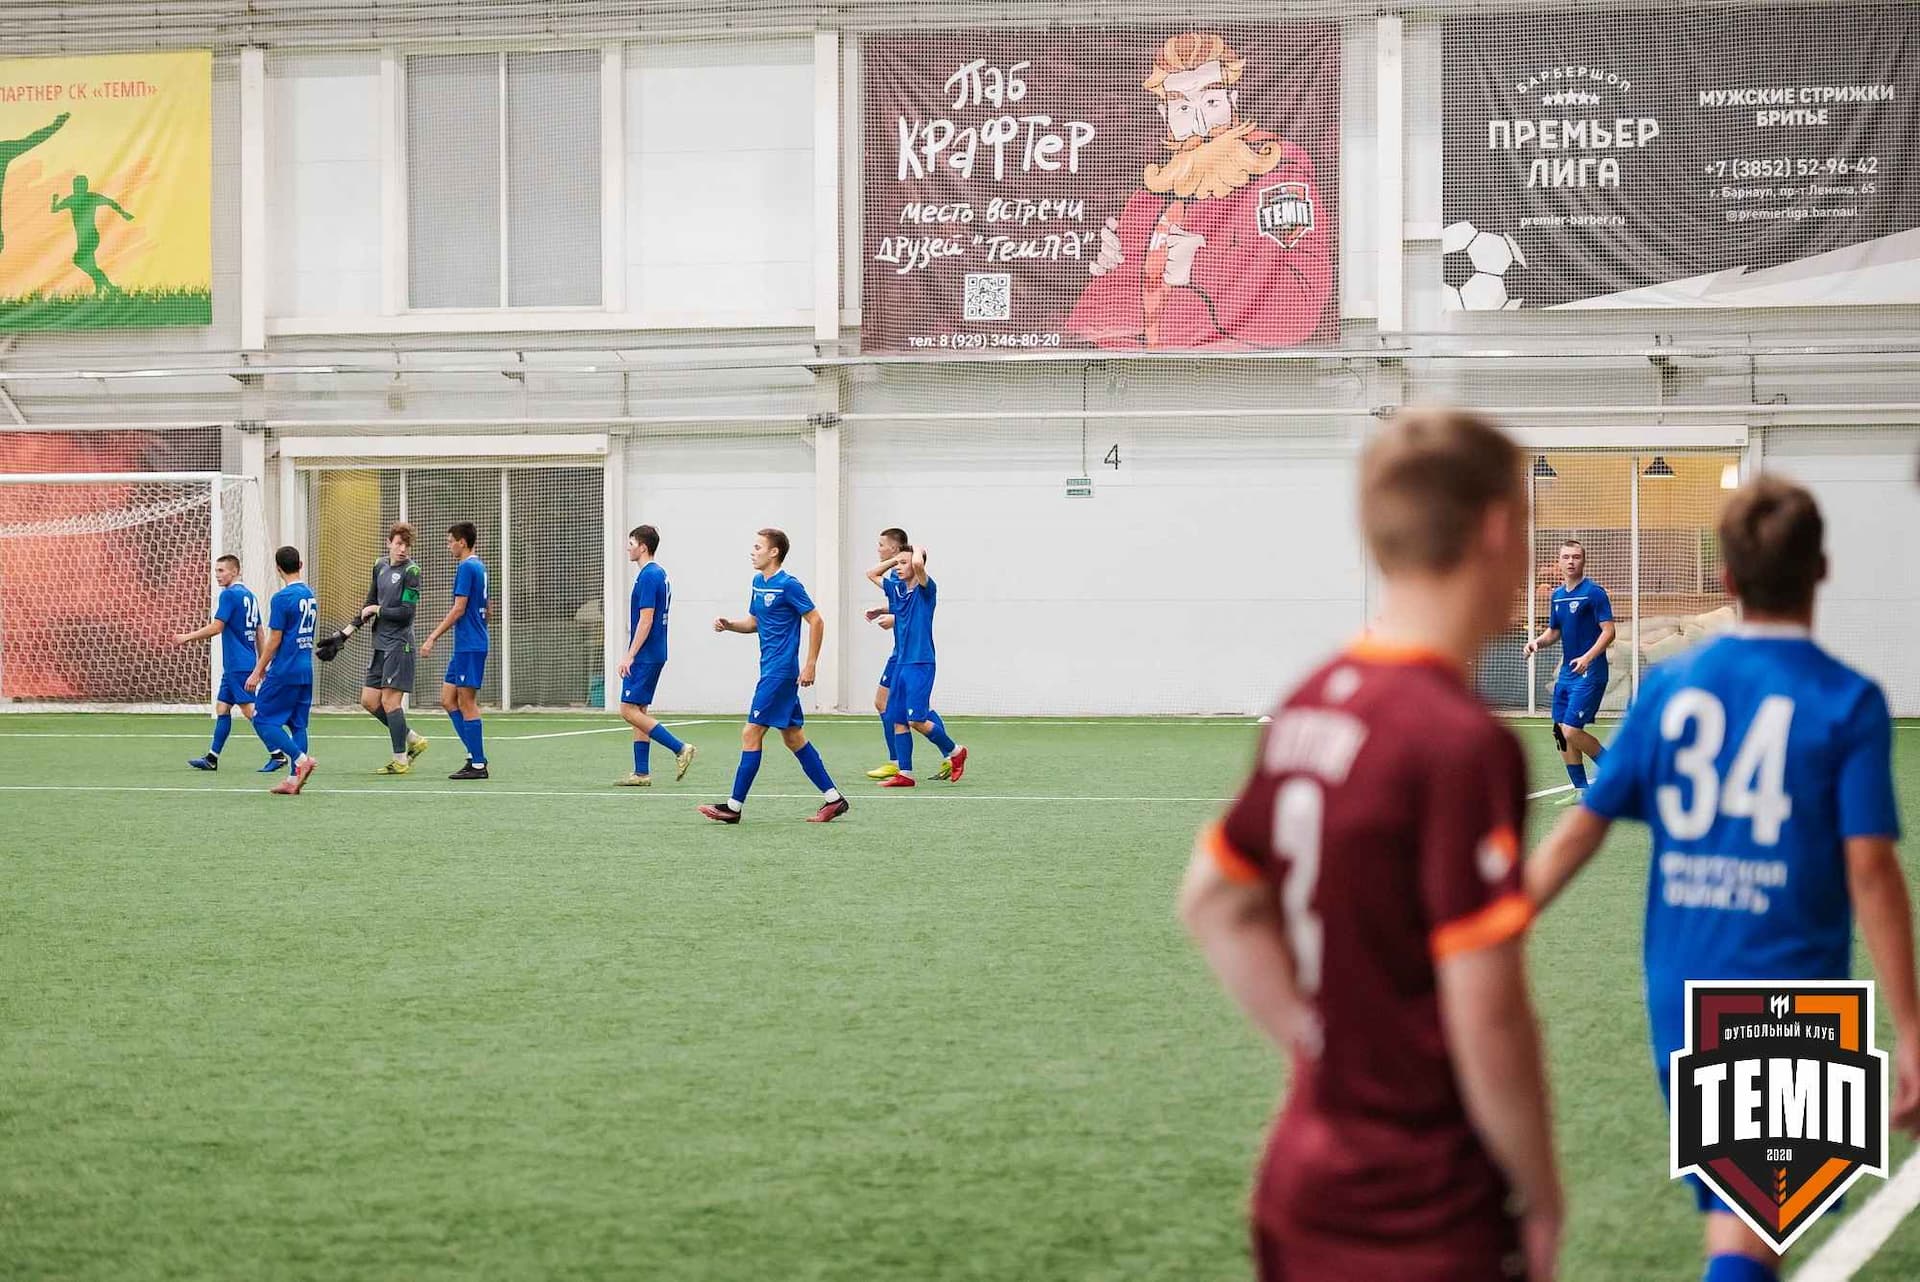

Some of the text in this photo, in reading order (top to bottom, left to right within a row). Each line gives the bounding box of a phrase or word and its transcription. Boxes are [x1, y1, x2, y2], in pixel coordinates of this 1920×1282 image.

[69, 83, 86, 100] СК
[93, 81, 158, 98] «ТЕМП»
[944, 59, 1030, 110] Паб
[1516, 67, 1631, 94] БАРБЕРШОП
[1699, 85, 1894, 106] МУЖСКИЕ СТРИЖКИ
[1756, 109, 1828, 126] БРИТЬЕ
[1488, 118, 1660, 149] ПРЕМЬЕР
[1527, 157, 1620, 188] ЛИГА
[1704, 157, 1877, 179] +7 (3852) 52-96-42
[1861, 182, 1875, 194] 65
[1261, 201, 1308, 229] ТЕМП
[1521, 214, 1625, 228] premier-barber.ru
[908, 333, 1061, 348] тел: 8 (929) 346-80-20
[1104, 443, 1122, 470] 4
[298, 598, 317, 634] 25
[1656, 687, 1795, 846] 34
